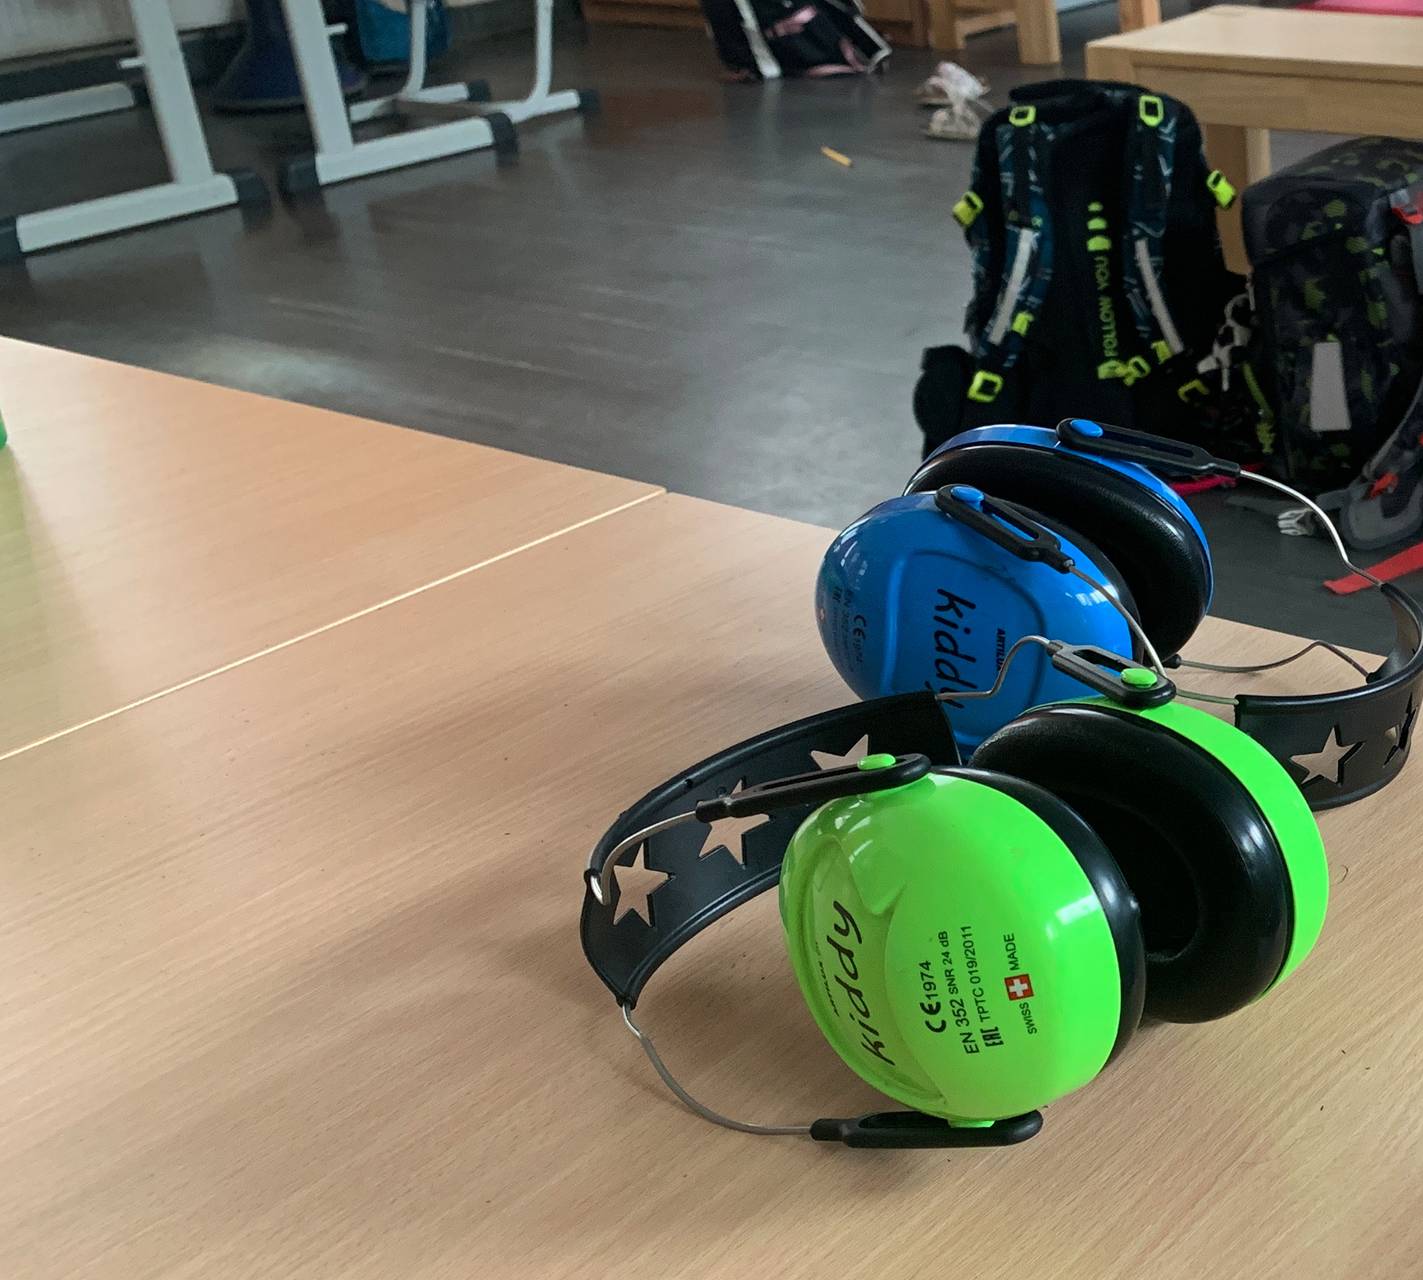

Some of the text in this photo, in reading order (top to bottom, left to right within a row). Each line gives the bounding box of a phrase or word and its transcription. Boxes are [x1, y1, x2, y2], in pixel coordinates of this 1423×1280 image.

[1093, 256, 1118, 357] FOLLOW YOU
[827, 900, 896, 1066] kiddy
[938, 930, 980, 1055] EN 352 SNR 24 dB
[961, 925, 982, 984] 019/2011
[972, 986, 991, 1022] TPTC
[1003, 933, 1038, 1034] SWISS MADE
